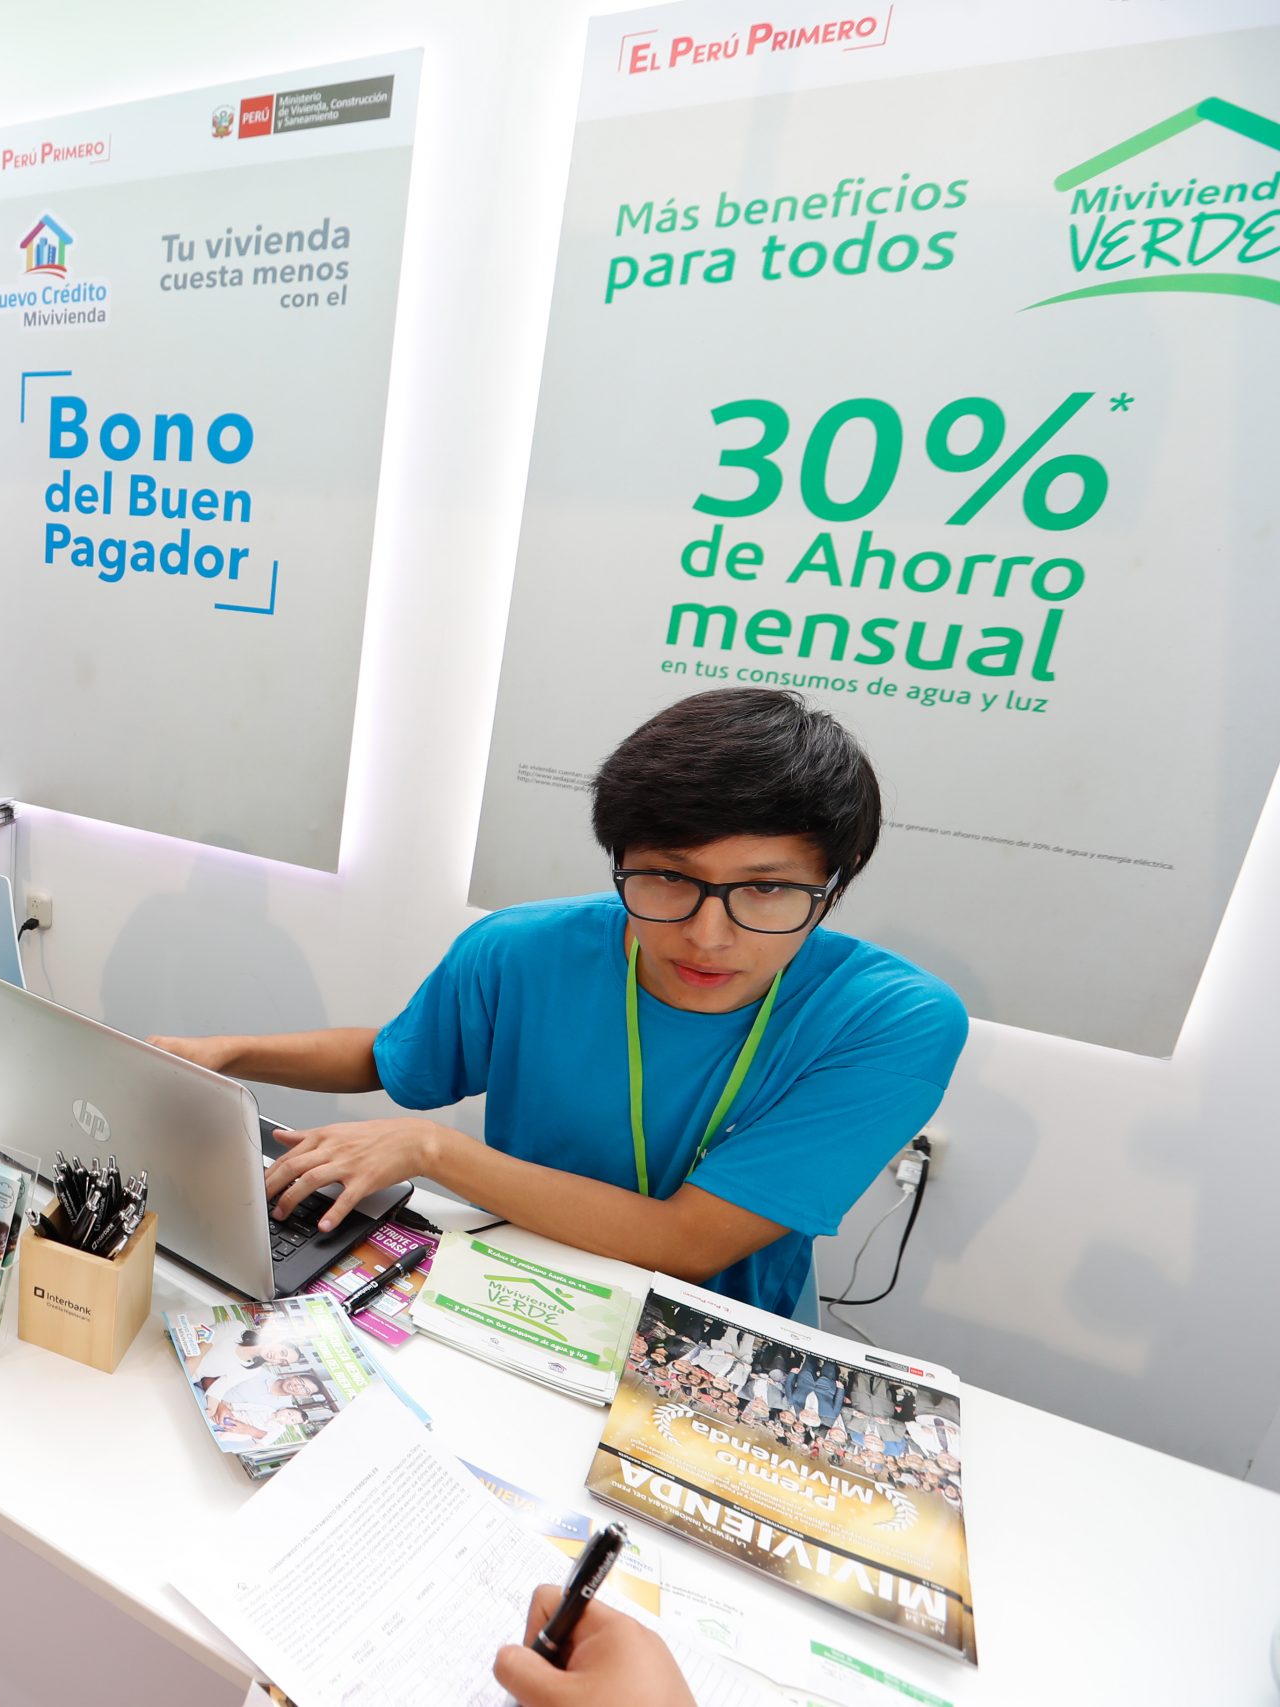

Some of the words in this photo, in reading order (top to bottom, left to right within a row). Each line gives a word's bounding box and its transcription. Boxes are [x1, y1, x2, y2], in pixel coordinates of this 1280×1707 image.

[628, 42, 661, 75] EL
[668, 33, 739, 70] PERÚ
[746, 16, 878, 58] PRIMERO
[242, 106, 270, 125] PERÚ
[278, 106, 290, 117] de
[290, 100, 329, 116] Vivienda,
[330, 90, 388, 110] Construcción
[279, 91, 322, 106] Ministerio
[277, 119, 283, 130] y
[284, 110, 339, 126] Saneamiento
[2, 147, 37, 170] PERÚ
[40, 141, 105, 164] PRIMERO
[615, 196, 700, 238] Más
[714, 173, 970, 228] beneficios
[1070, 171, 1280, 215] Miviviend
[161, 233, 196, 264] Tu
[205, 217, 351, 260] vivienda
[1069, 209, 1280, 273] VERDE
[159, 263, 244, 292] cuesta
[253, 260, 349, 286] menos
[605, 244, 737, 304] para
[760, 220, 959, 281] todos
[41, 282, 107, 305] Crédito
[280, 289, 321, 310] con
[326, 285, 347, 308] el
[23, 307, 106, 327] Mivivienda
[49, 395, 254, 464] Bono
[45, 469, 112, 515] del
[129, 474, 251, 523] Buen
[44, 522, 250, 583] Pagador
[680, 524, 764, 581] de
[786, 530, 1085, 602] Ahorro
[665, 601, 1065, 683] mensual
[661, 658, 687, 675] en
[694, 660, 730, 679] tus
[736, 665, 859, 694] consumos
[867, 676, 898, 698] de
[906, 684, 971, 707] agua
[980, 692, 999, 713] y
[1005, 690, 1049, 714] luz
[372, 1231, 386, 1241] TU
[383, 1238, 408, 1255] CASA
[378, 1225, 412, 1247] STRUYE
[46, 1292, 92, 1317] Interbank
[487, 1288, 560, 1327] VERDE
[488, 1280, 565, 1315] Mivivienda
[691, 1420, 873, 1505] Mivivienda
[716, 1450, 837, 1512] Premio
[631, 1488, 647, 1500] DEL
[619, 1458, 947, 1622] MIVIVIENDA
[700, 1522, 734, 1543] REVISTA
[734, 1538, 746, 1548] LA
[590, 1551, 617, 1590] Interbank
